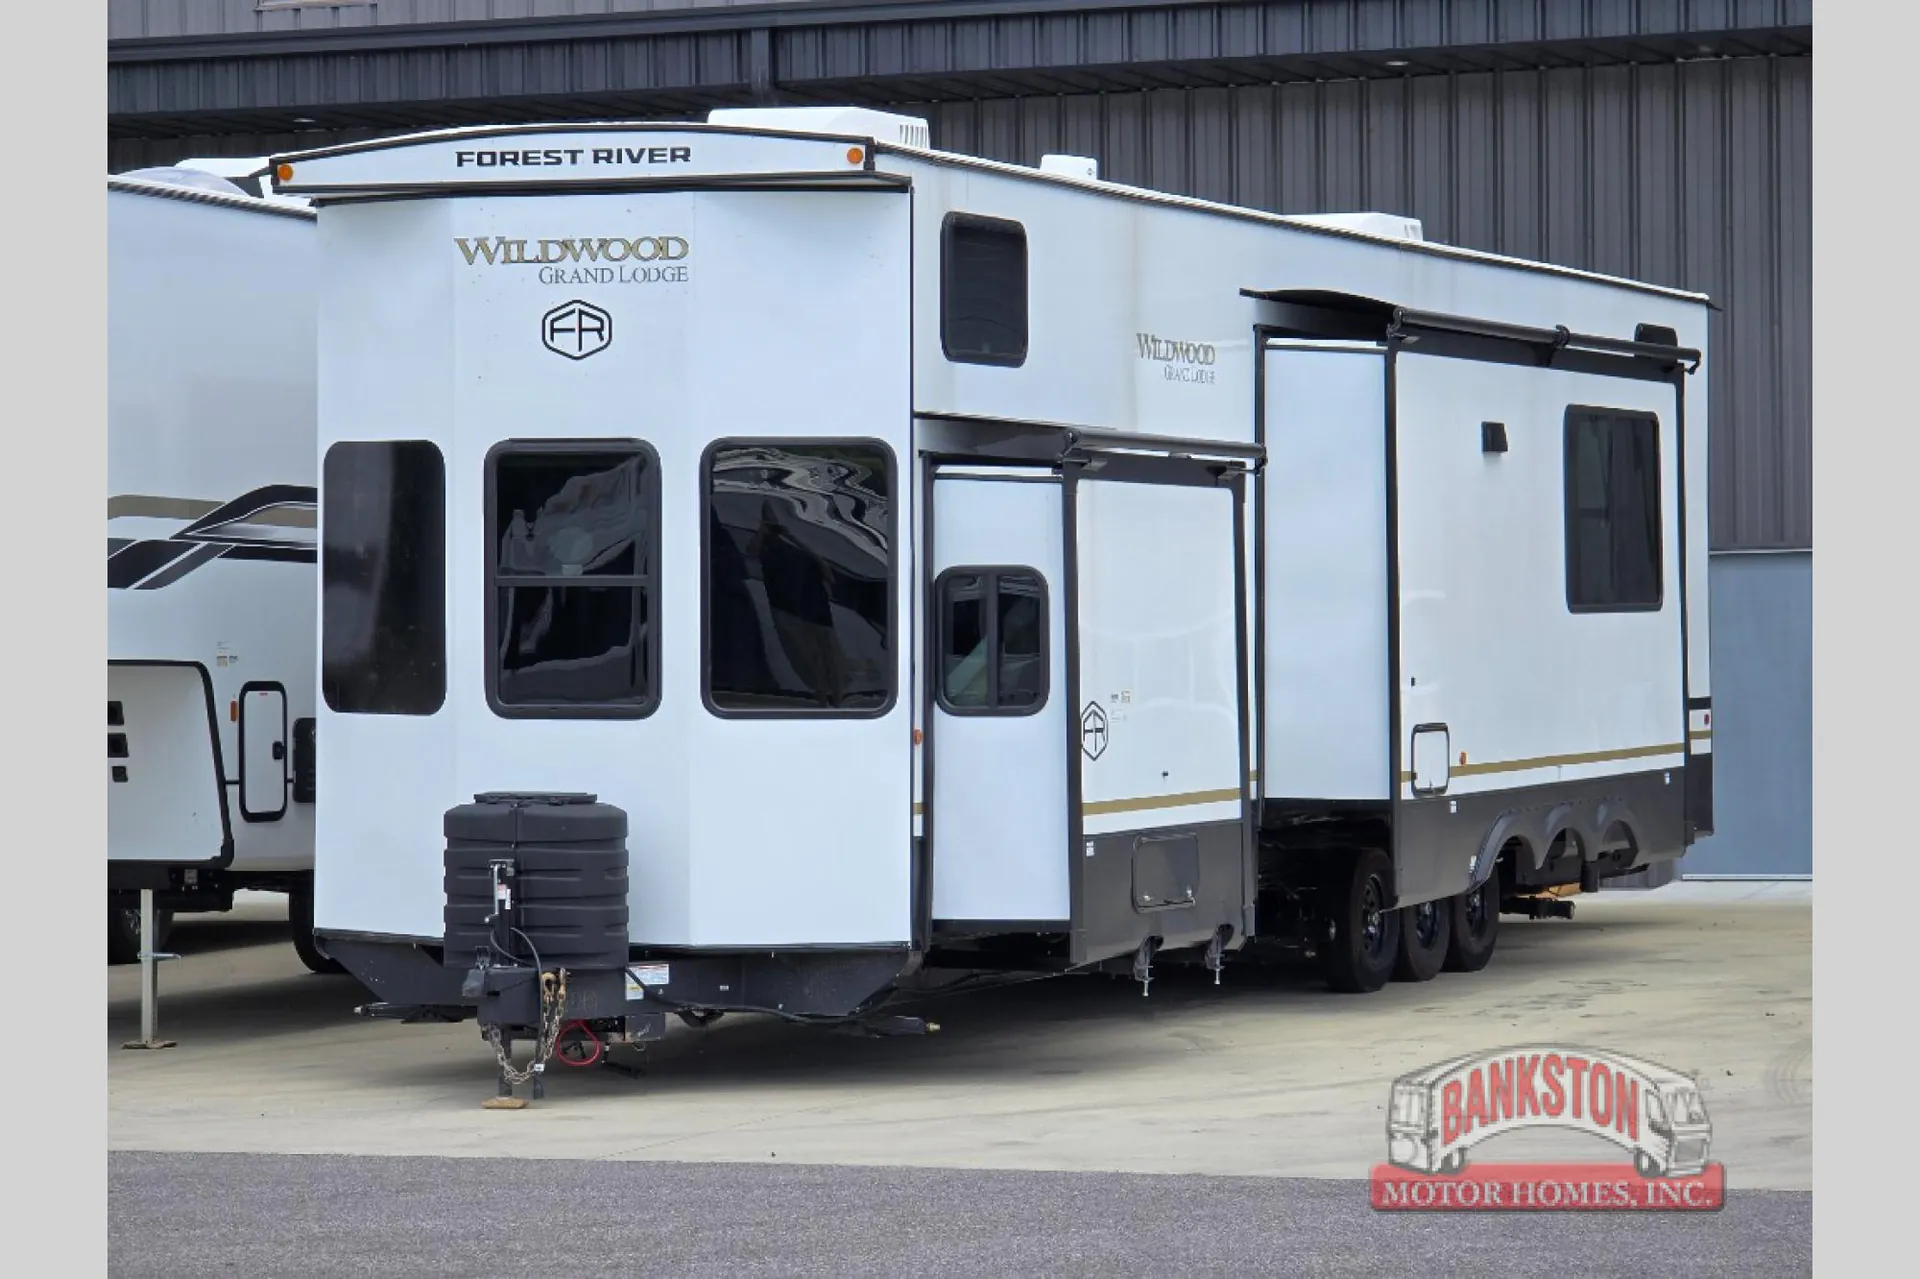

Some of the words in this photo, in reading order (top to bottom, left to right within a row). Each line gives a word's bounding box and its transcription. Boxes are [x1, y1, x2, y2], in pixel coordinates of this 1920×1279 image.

[456, 149, 584, 167] FOREST
[592, 146, 691, 164] RIVER
[453, 236, 690, 265] WILDWOOD
[538, 266, 614, 285] GRAND
[619, 265, 689, 284] LODGE
[1136, 332, 1216, 366] WILDWOOD
